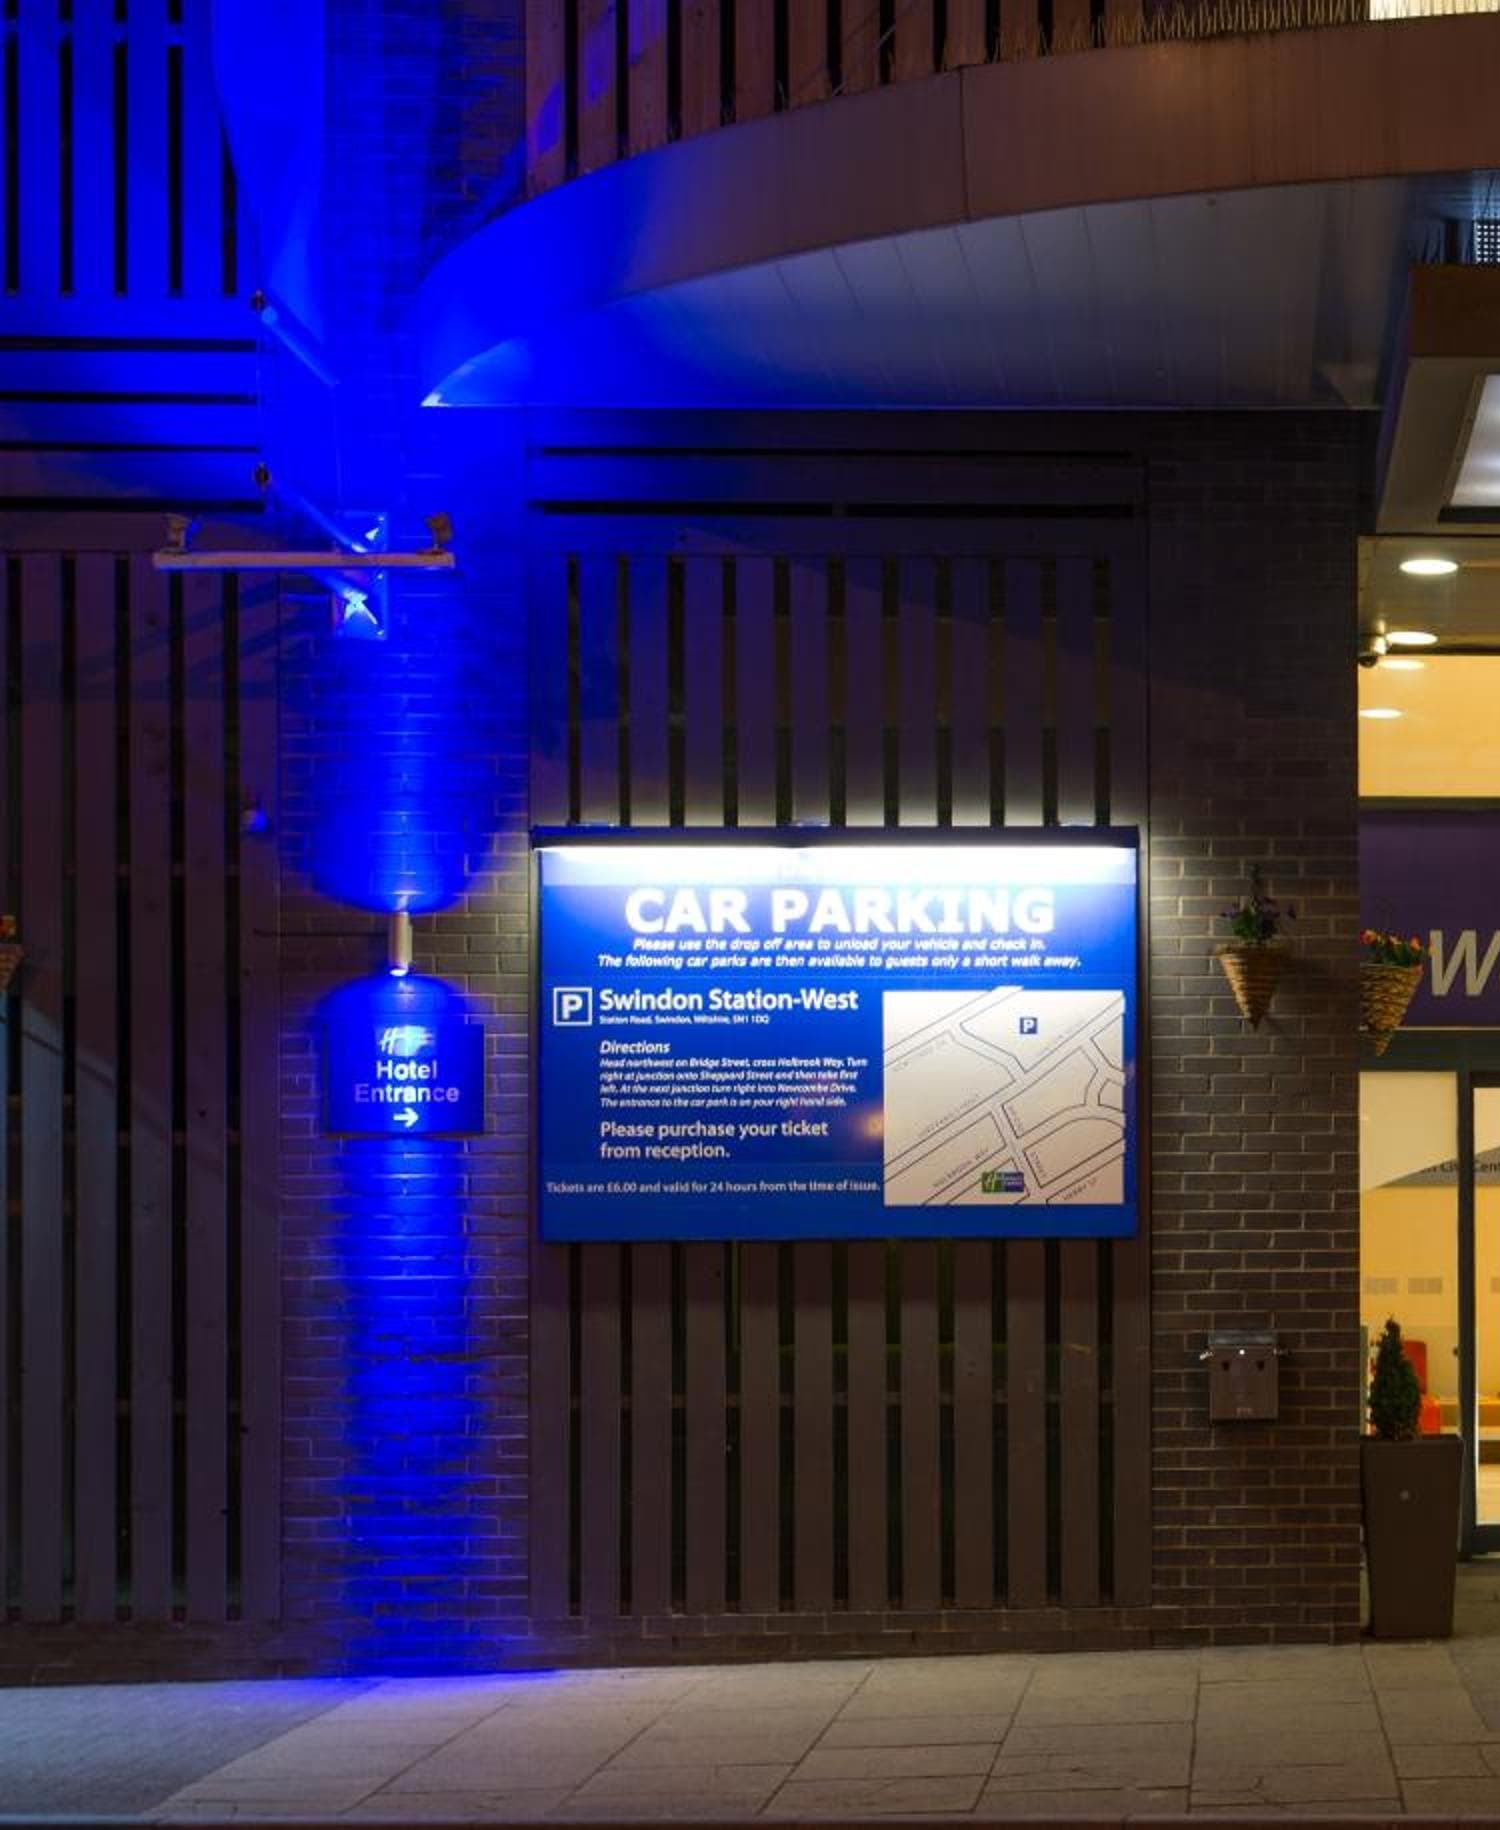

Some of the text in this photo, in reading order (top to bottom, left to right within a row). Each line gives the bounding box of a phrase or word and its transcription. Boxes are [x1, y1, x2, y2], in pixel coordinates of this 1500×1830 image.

[625, 886, 1056, 934] CAR PARKING
[633, 938, 1046, 954] Please use the drop off area to unload your vehicle and check in.
[598, 954, 1081, 970] The following car parks are then available to guests only a short walk away.
[600, 988, 859, 1011] Swindon Station-West
[600, 1039, 671, 1054] Directions
[375, 1060, 438, 1081] Hotel
[353, 1083, 460, 1103] Entrance
[600, 1120, 829, 1141] Please purchase your ticket
[600, 1142, 731, 1162] from reception.
[547, 1180, 881, 1193] Tickets are £6.00 and valid for 24 hours from the time of issue.
